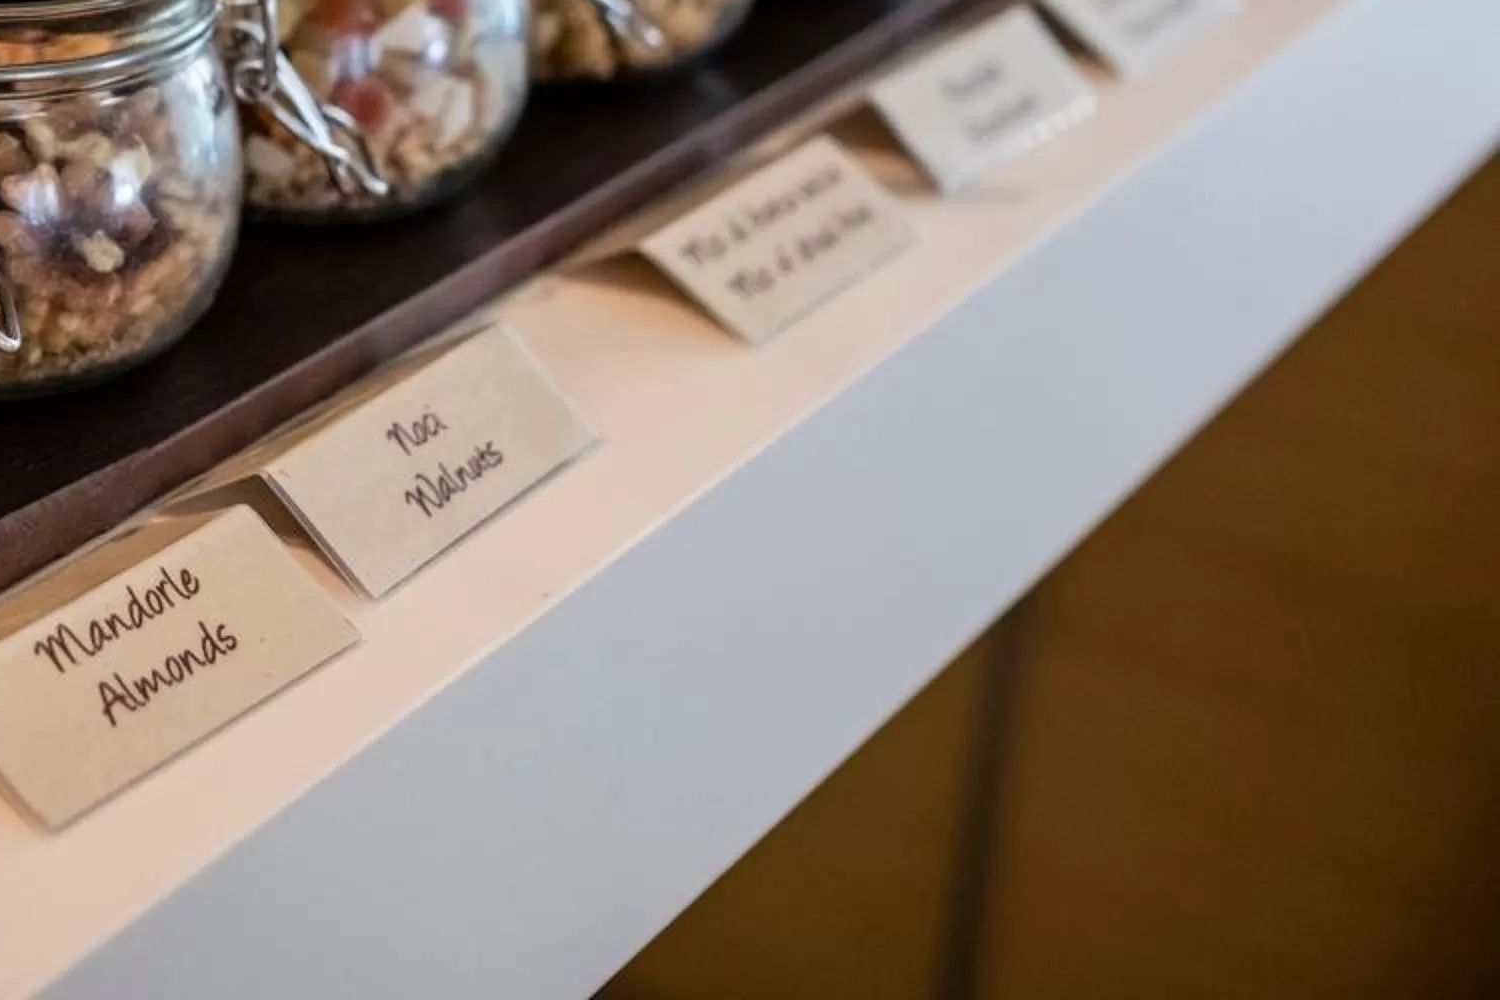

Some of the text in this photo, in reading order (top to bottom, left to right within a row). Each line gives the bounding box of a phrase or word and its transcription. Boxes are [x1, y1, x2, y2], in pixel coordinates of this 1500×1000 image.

[386, 404, 449, 457] Noci
[404, 440, 504, 518] Walnuts
[33, 565, 201, 674] Mandorle
[97, 619, 239, 728] Almonds
